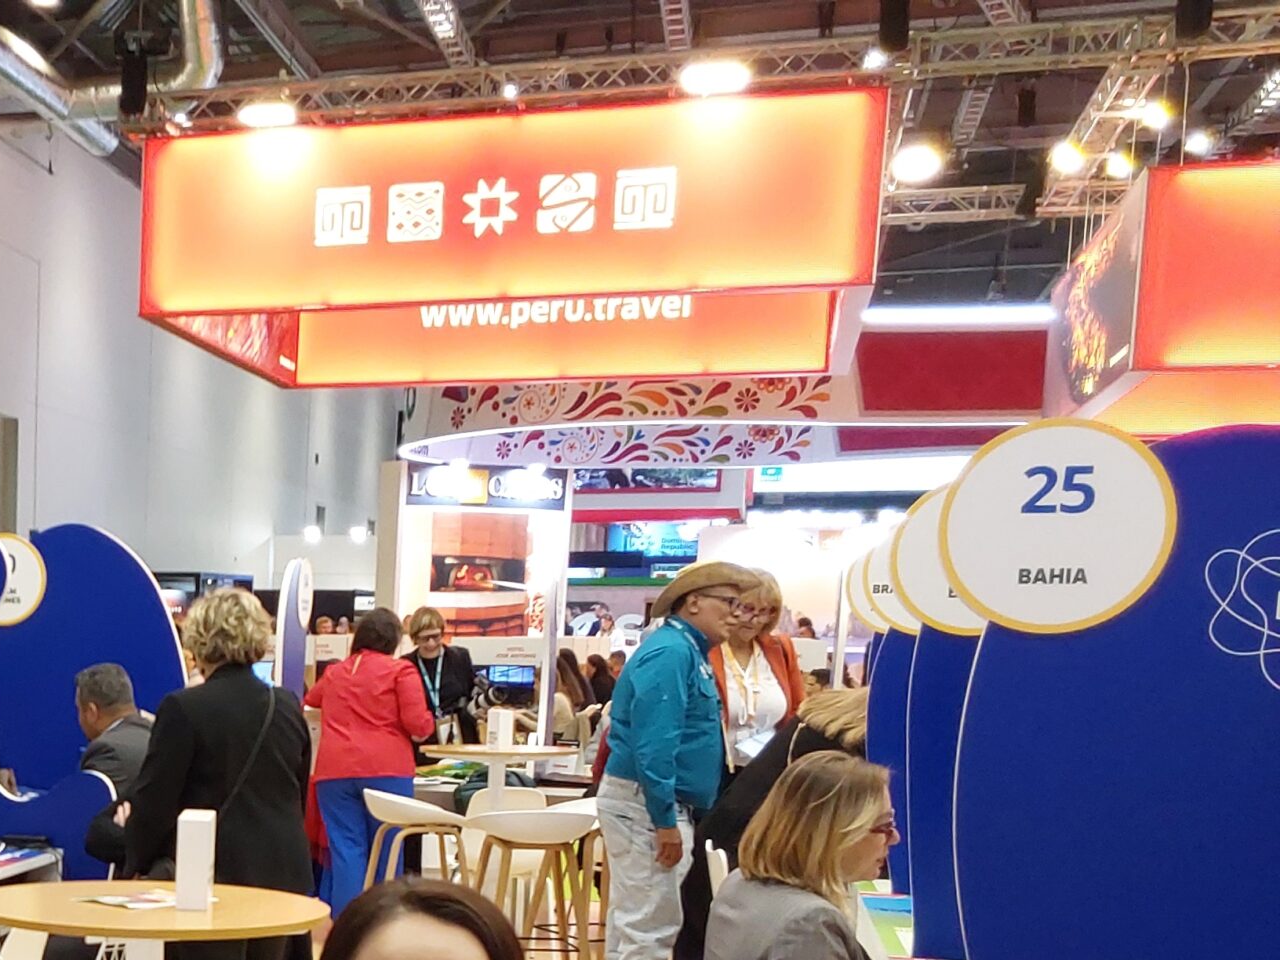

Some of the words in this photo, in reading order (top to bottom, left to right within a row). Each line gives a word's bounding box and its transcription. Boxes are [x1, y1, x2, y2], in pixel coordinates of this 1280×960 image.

[420, 295, 692, 328] www.peru.travel
[1021, 465, 1096, 514] 25
[1018, 568, 1088, 585] BAHIA
